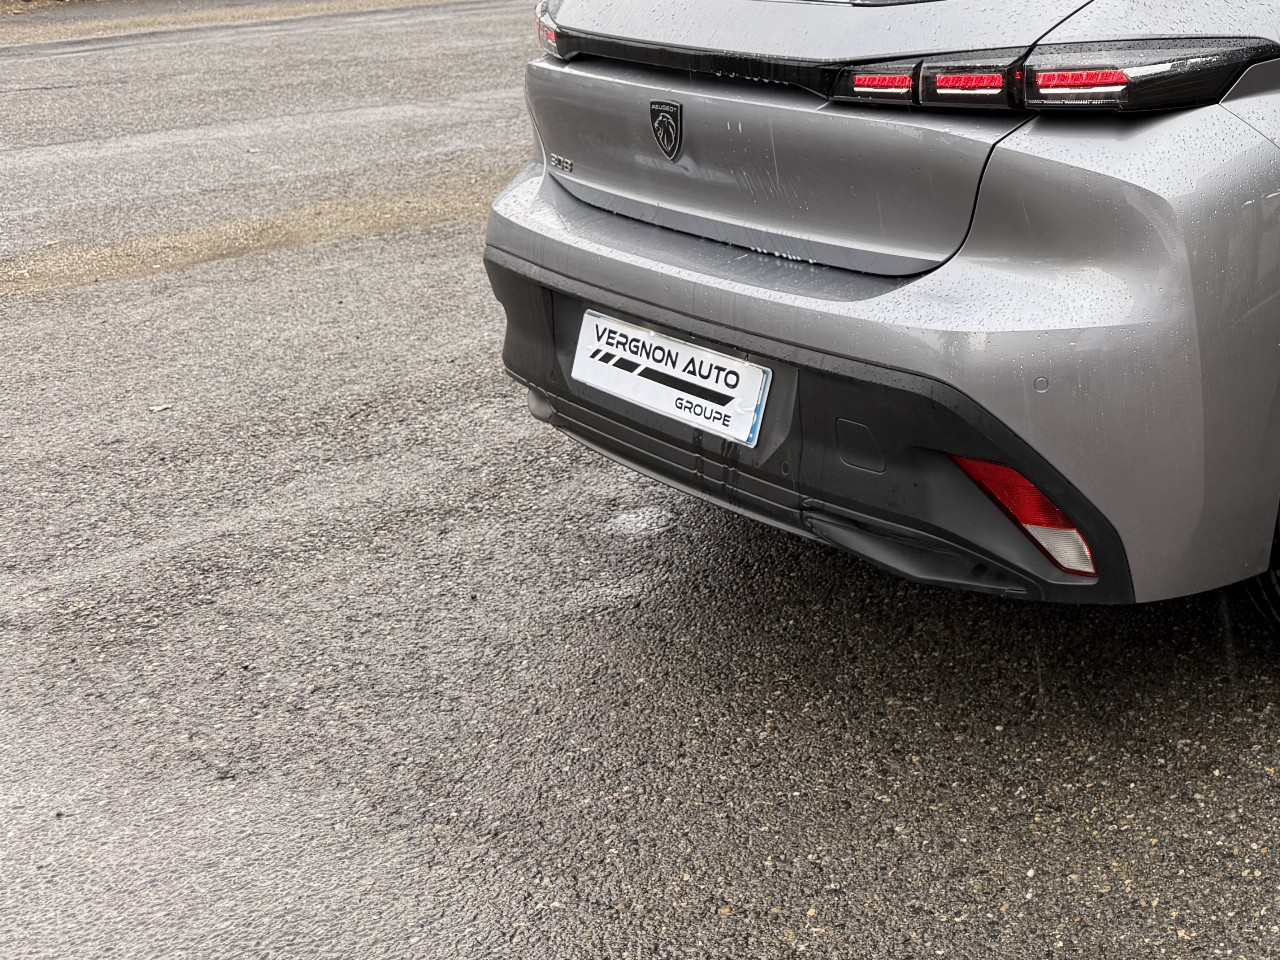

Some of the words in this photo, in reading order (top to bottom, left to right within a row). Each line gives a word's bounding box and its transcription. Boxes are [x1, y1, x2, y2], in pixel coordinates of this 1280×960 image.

[651, 104, 677, 112] PEUGEOT
[550, 152, 573, 173] 308
[595, 324, 679, 369] VERGNON
[682, 356, 740, 390] AUTO
[674, 396, 732, 428] GROUPE
